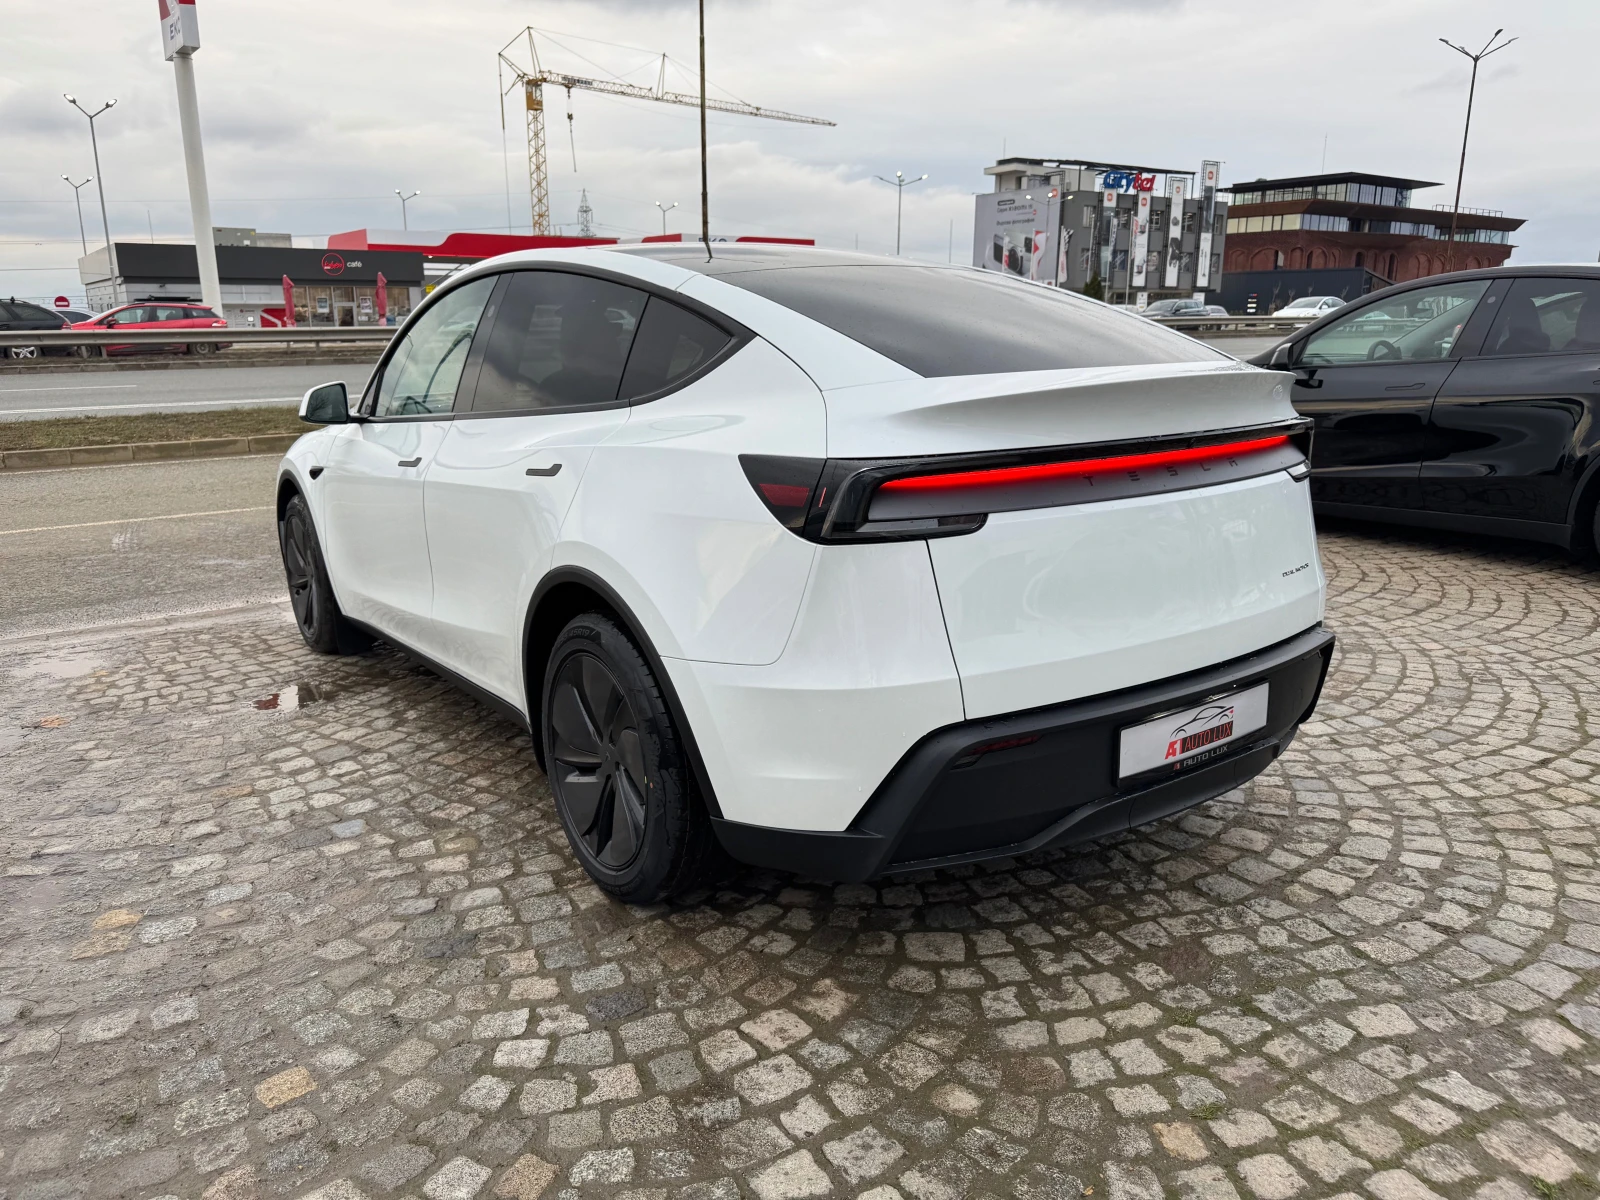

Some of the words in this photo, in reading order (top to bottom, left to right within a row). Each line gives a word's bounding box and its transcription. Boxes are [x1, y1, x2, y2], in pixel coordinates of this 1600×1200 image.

[1103, 170, 1156, 193] Citytel
[1082, 456, 1239, 487] TESLA
[1184, 729, 1211, 752] AUTO
[1213, 722, 1232, 742] LUX
[1183, 753, 1208, 767] AUTO
[1211, 745, 1229, 757] LUX
